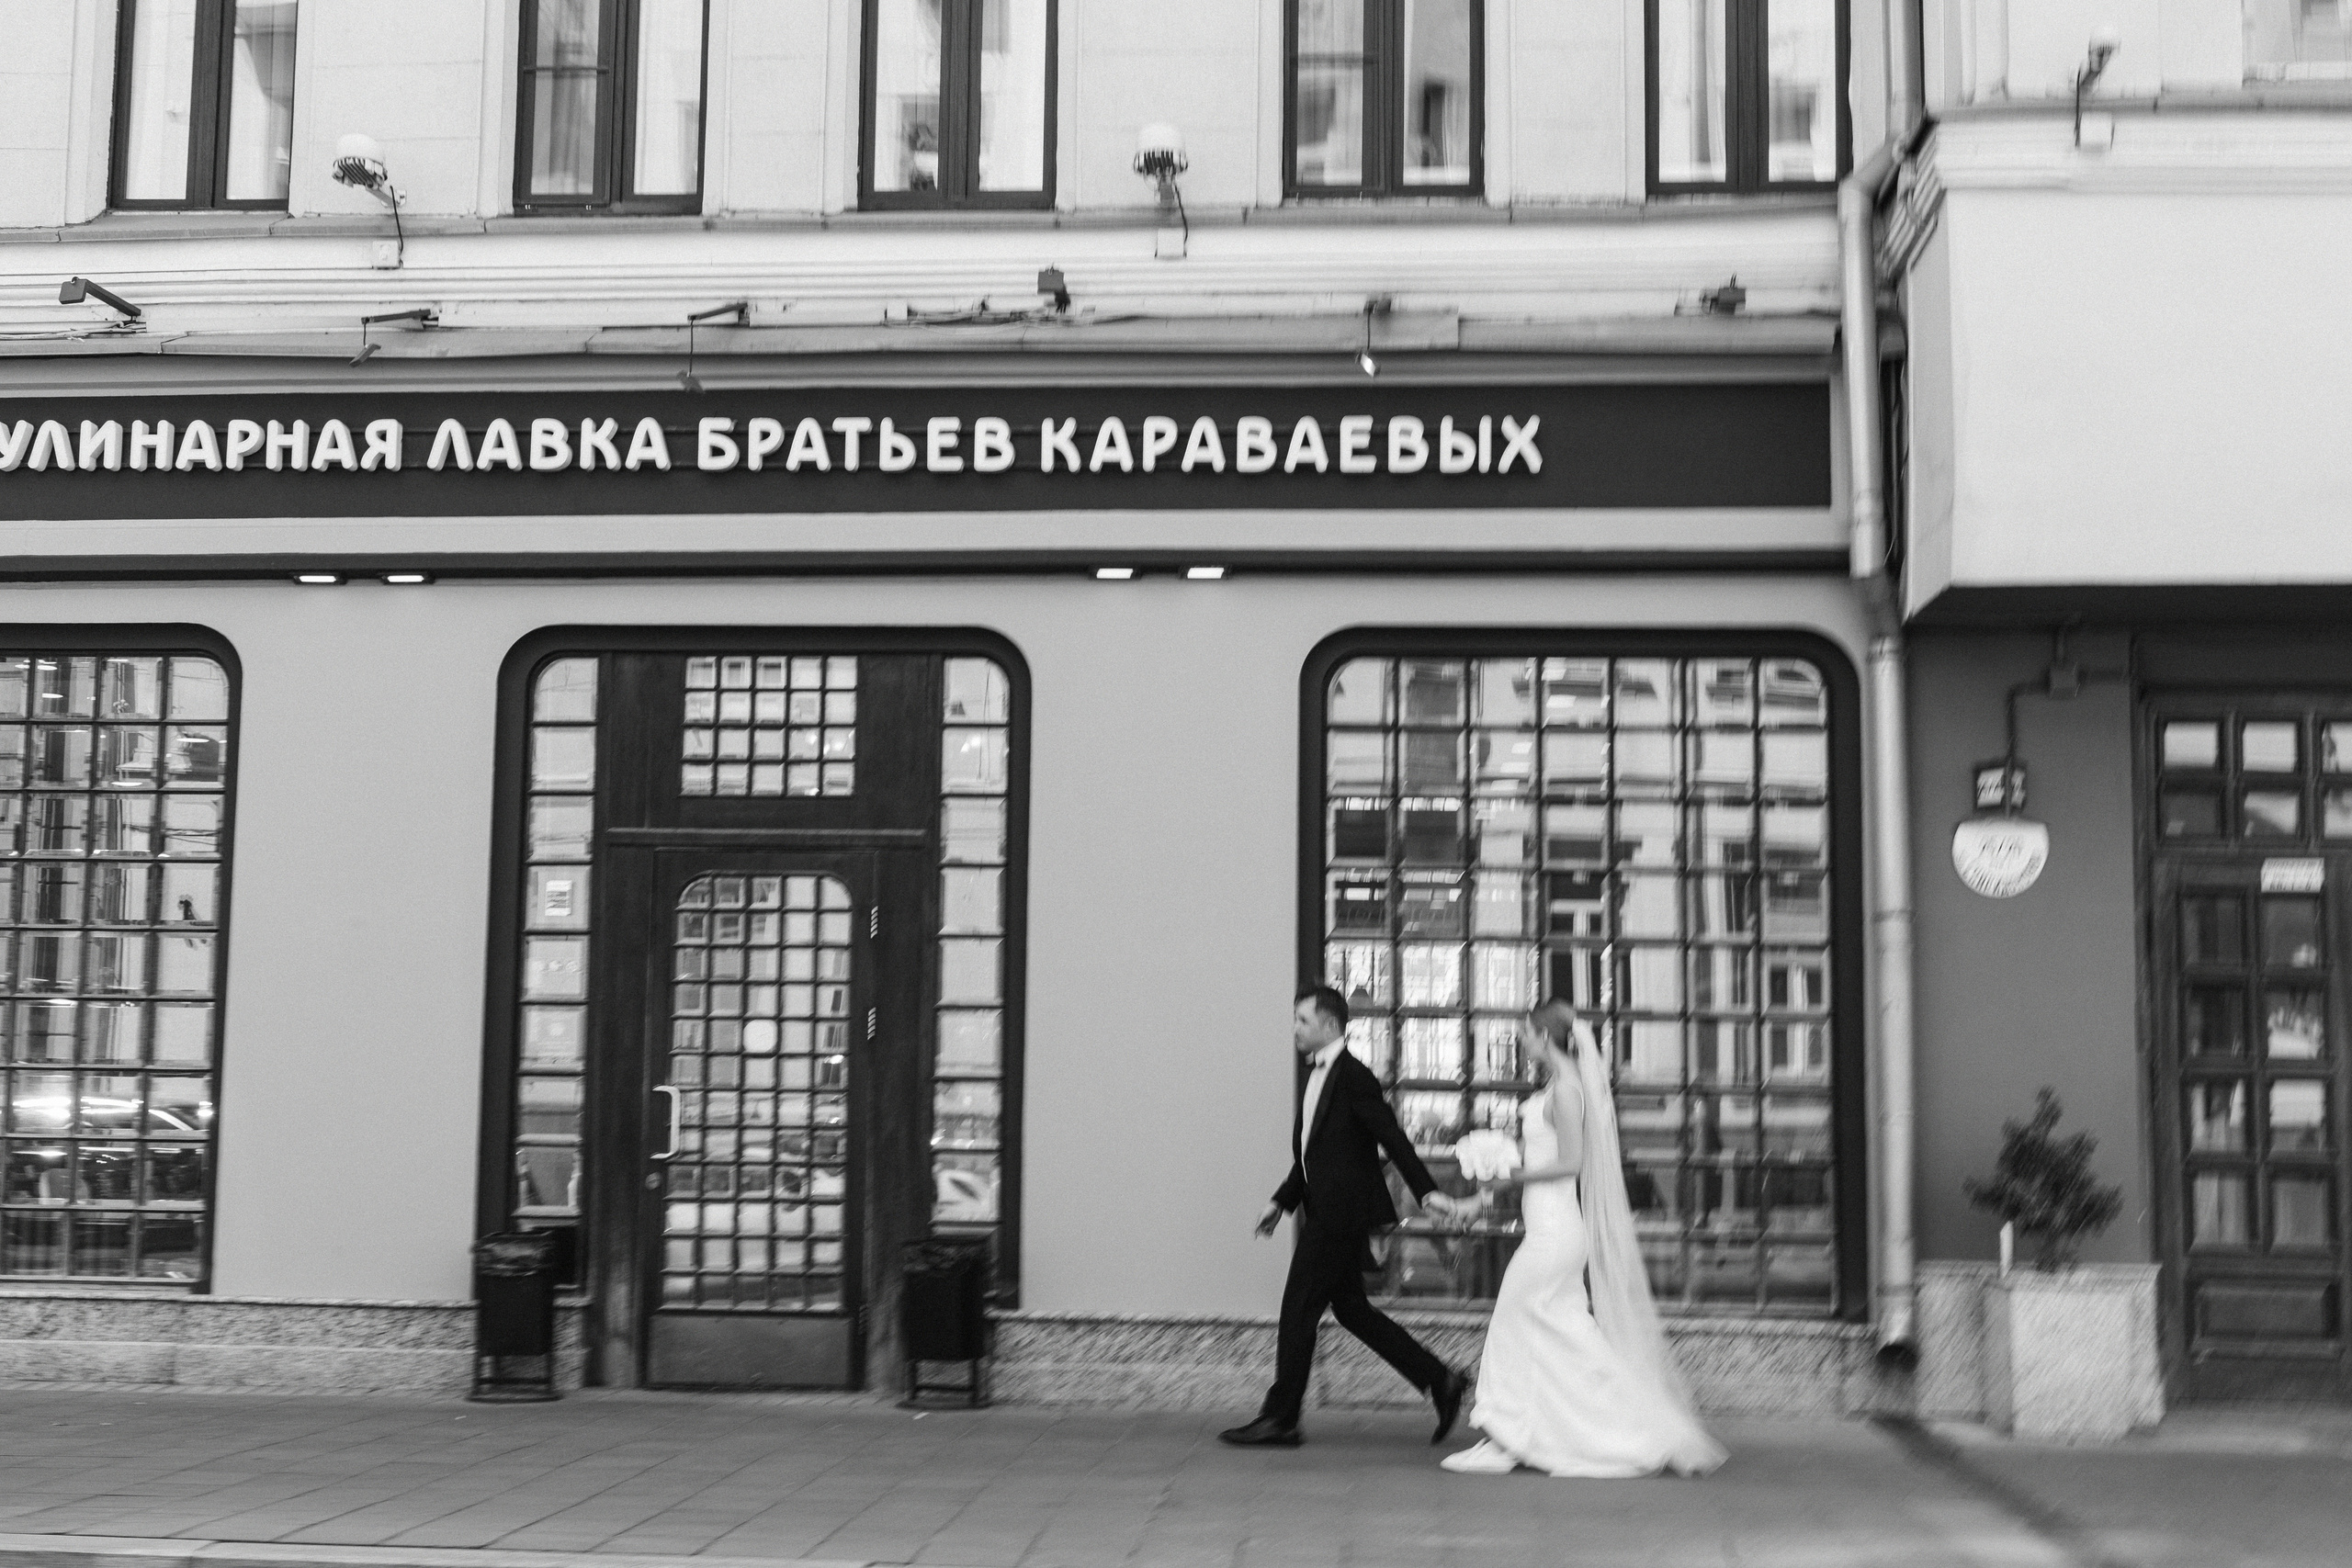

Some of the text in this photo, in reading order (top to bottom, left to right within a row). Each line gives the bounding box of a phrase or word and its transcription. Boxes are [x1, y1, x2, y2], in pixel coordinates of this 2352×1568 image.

[426, 417, 672, 471] ЛАВКА
[696, 416, 1015, 472] БРАТЬЕВ
[1040, 414, 1544, 473] КАРАВАЕВЫХ
